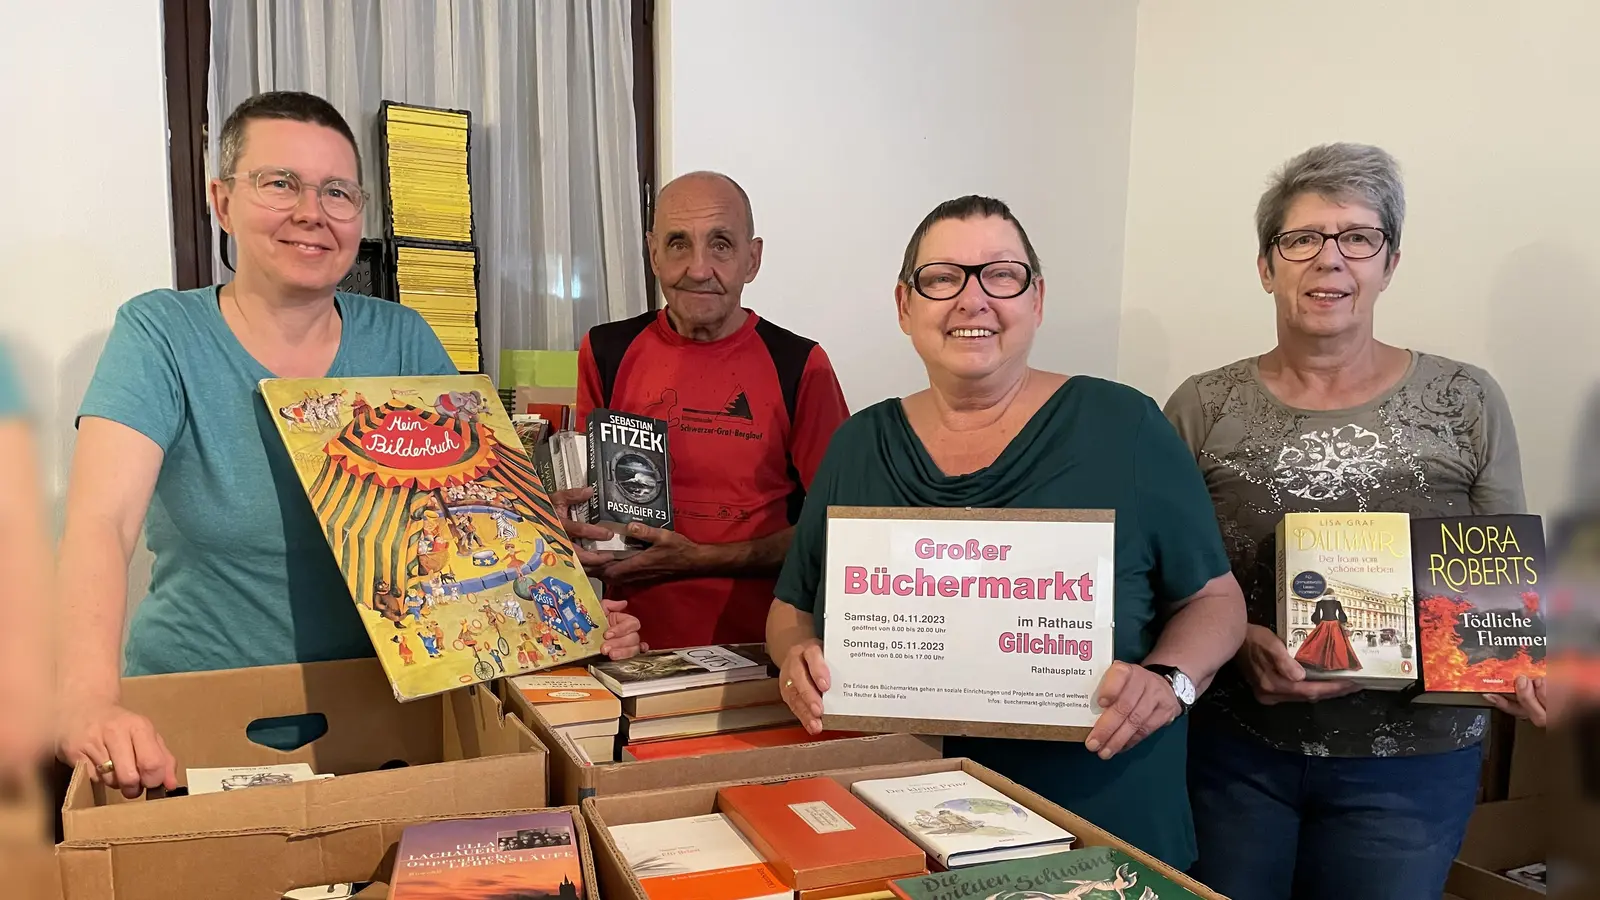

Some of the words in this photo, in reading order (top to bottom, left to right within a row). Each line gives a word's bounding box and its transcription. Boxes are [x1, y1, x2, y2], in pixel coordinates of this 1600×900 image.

[387, 416, 428, 431] Mein
[609, 414, 653, 432] SEBASTIAN
[365, 430, 460, 457] Bilderbuch
[600, 422, 664, 453] FITZEK
[607, 501, 653, 517] PASSAGIER
[655, 510, 667, 520] 23
[1320, 518, 1341, 527] LISA
[1346, 519, 1375, 527] GRAF
[1293, 526, 1405, 558] DALLMAYR
[1441, 522, 1520, 555] NORA
[914, 538, 1012, 561] Großer
[1318, 554, 1335, 563] Der
[1337, 554, 1359, 563] Traum
[1326, 565, 1365, 575] schönen
[1366, 565, 1394, 573] Leben
[1428, 554, 1538, 593] ROBERTS
[844, 566, 1094, 602] Büchermarkt
[532, 592, 554, 607] KASSE
[844, 612, 890, 624] Samstag,
[892, 614, 945, 624] 04.11.2023
[1017, 616, 1033, 627] im
[1038, 616, 1093, 629] Rathaus
[1459, 612, 1532, 628] Tödliche
[851, 624, 878, 632] geöffnet
[843, 639, 889, 651] Sonntag,
[891, 640, 945, 651] 05.11.2023
[998, 631, 1093, 661] Gilching
[849, 651, 876, 659] geöffnet
[1031, 666, 1086, 677] Rathausplatz
[1088, 668, 1093, 676] 1
[880, 684, 919, 692] Büchermarktes
[963, 687, 1000, 696] Einrichtungen
[1012, 690, 1034, 698] Projekte
[907, 785, 937, 793] kleine
[940, 782, 968, 790] Prinz
[456, 841, 496, 850] ULLA
[408, 847, 498, 861] LACHAUER
[449, 850, 575, 869] LEBENSLÄUFE
[921, 872, 960, 894] Die
